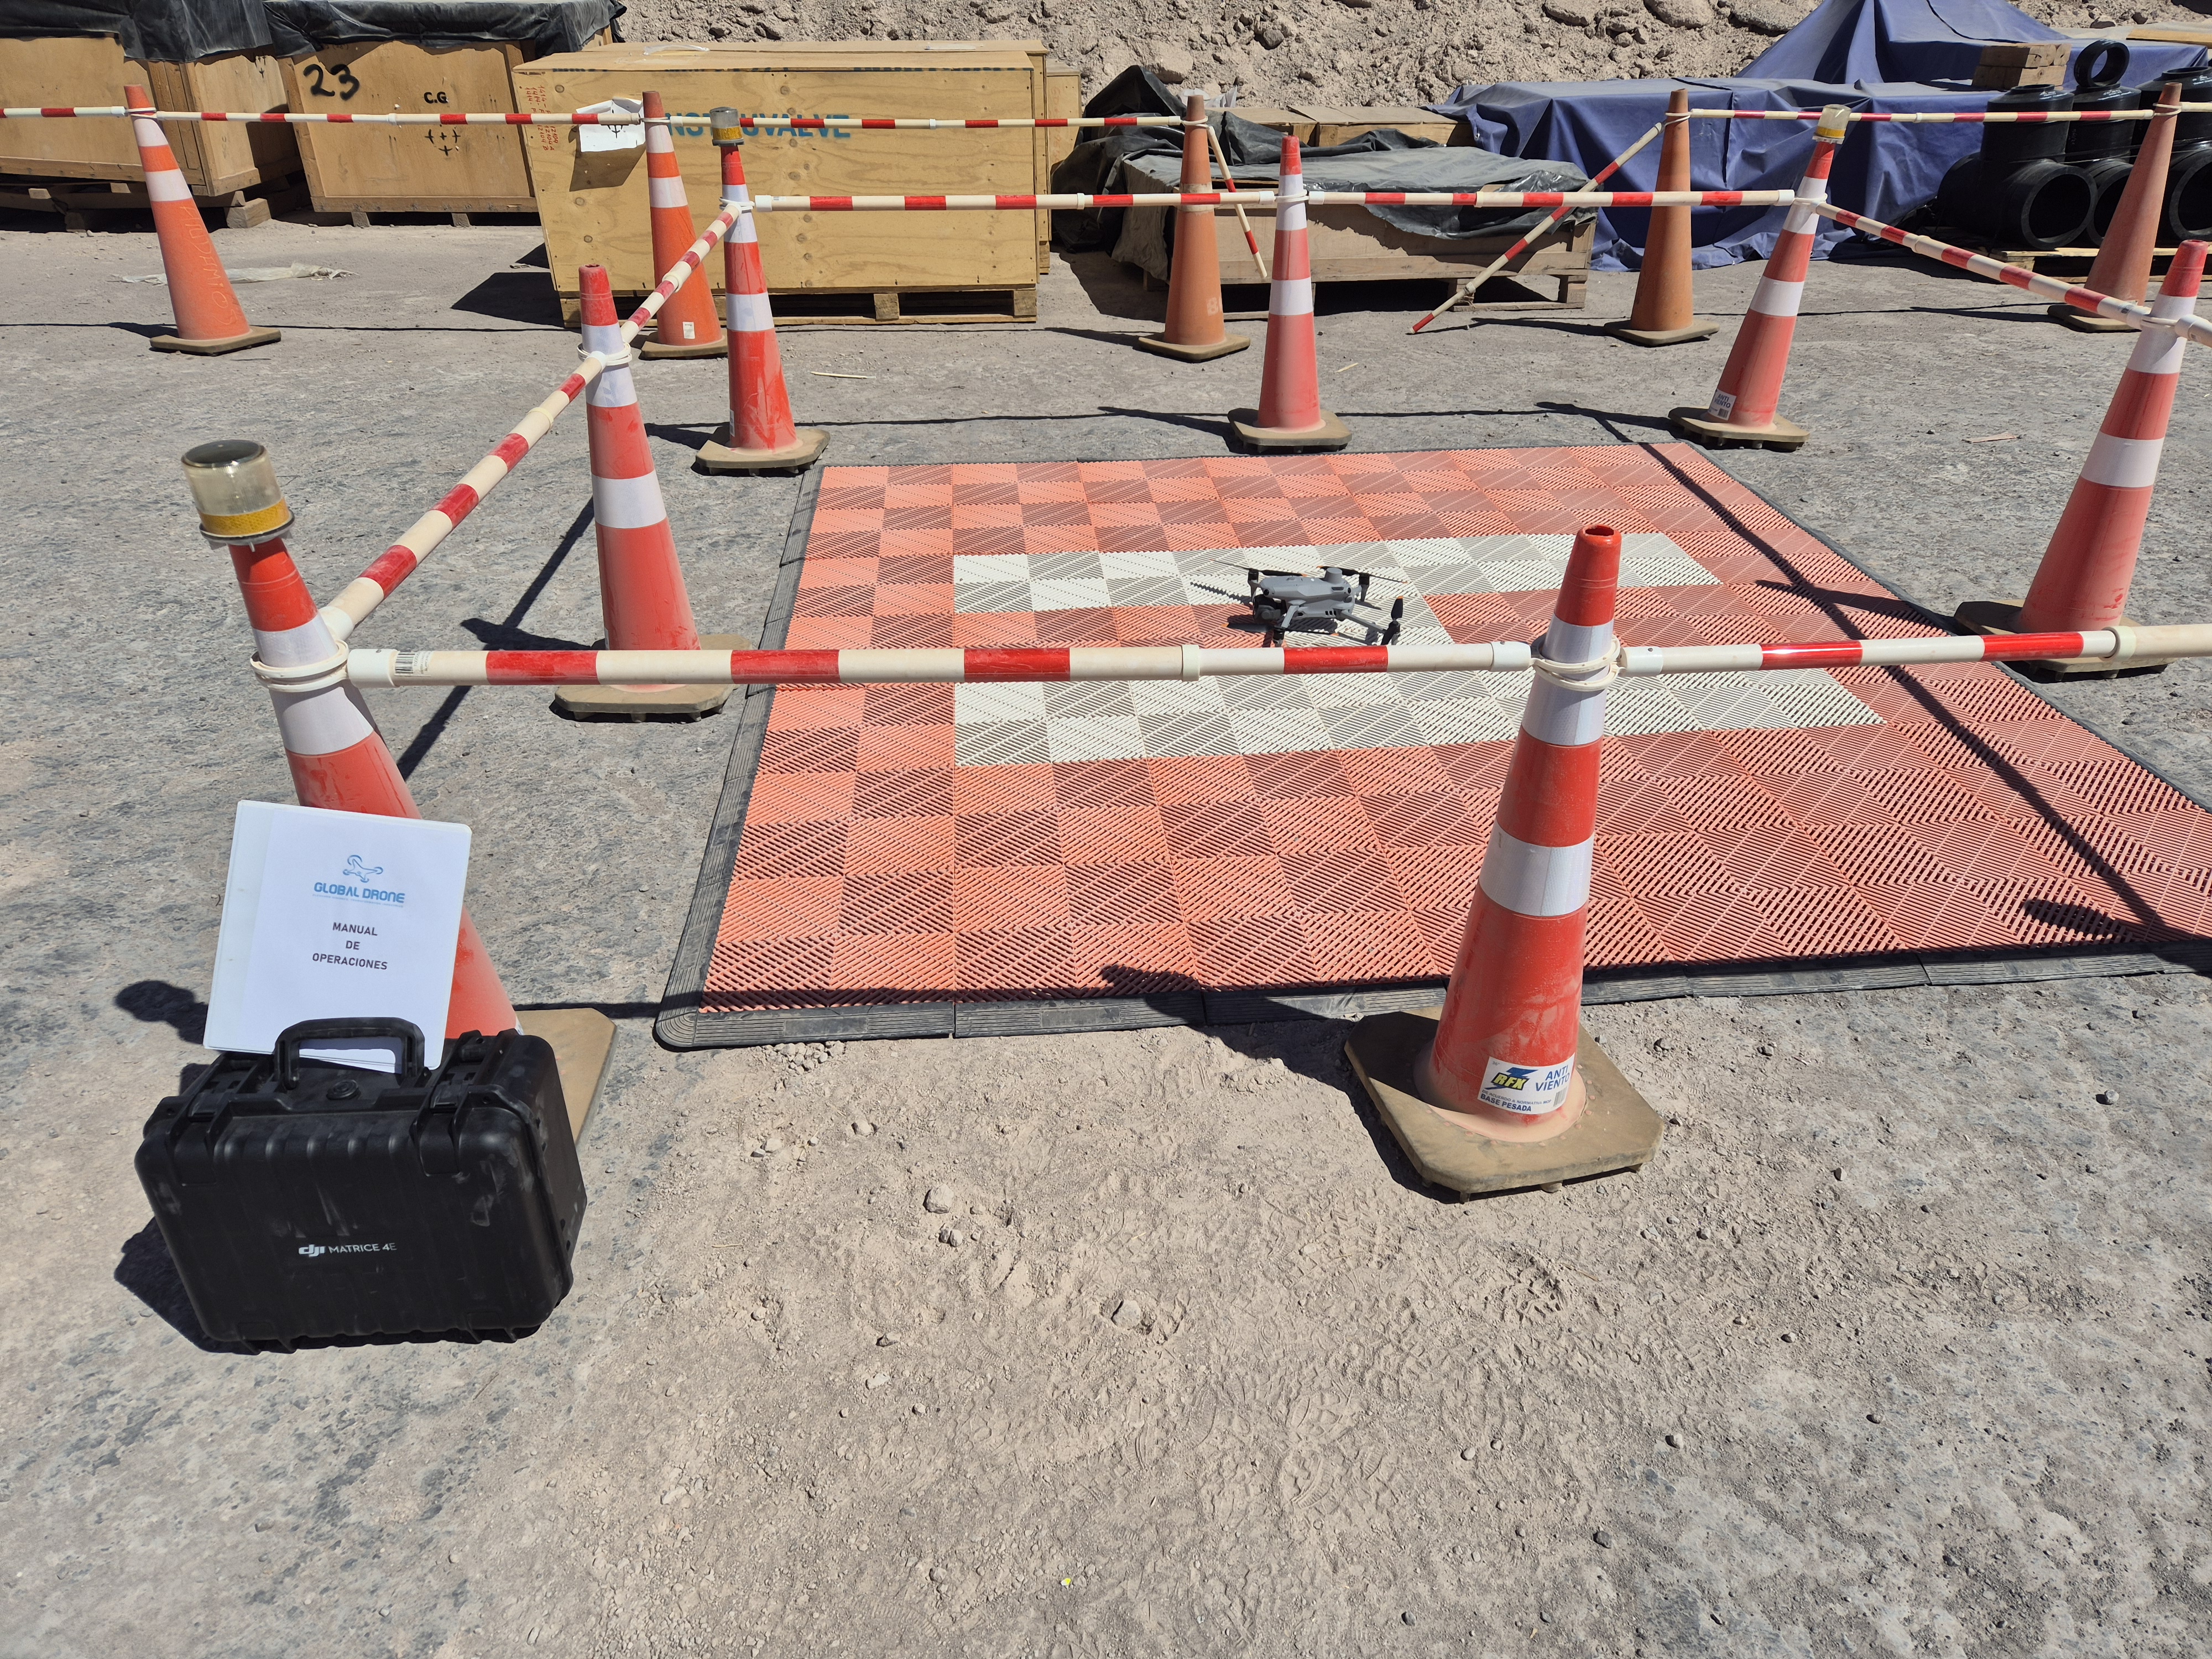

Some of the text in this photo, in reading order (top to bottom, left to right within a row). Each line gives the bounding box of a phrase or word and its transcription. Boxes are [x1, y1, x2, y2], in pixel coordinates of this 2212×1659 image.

[303, 64, 360, 101] 23
[1718, 394, 1730, 402] ANTI
[314, 882, 359, 898] GLOBAL
[362, 888, 405, 903] DRONE
[332, 922, 378, 936] MANUAL
[346, 940, 361, 950] DE
[312, 953, 388, 970] OPERACIONES
[1493, 1073, 1527, 1089] RFX
[1545, 1065, 1569, 1081] ANTI
[1535, 1072, 1570, 1092] VIENTO
[1480, 1093, 1532, 1112] BASE PESADA
[1489, 1092, 1511, 1102] ACUERDO
[328, 1243, 380, 1254] MATRICE
[382, 1243, 397, 1251] 4E
